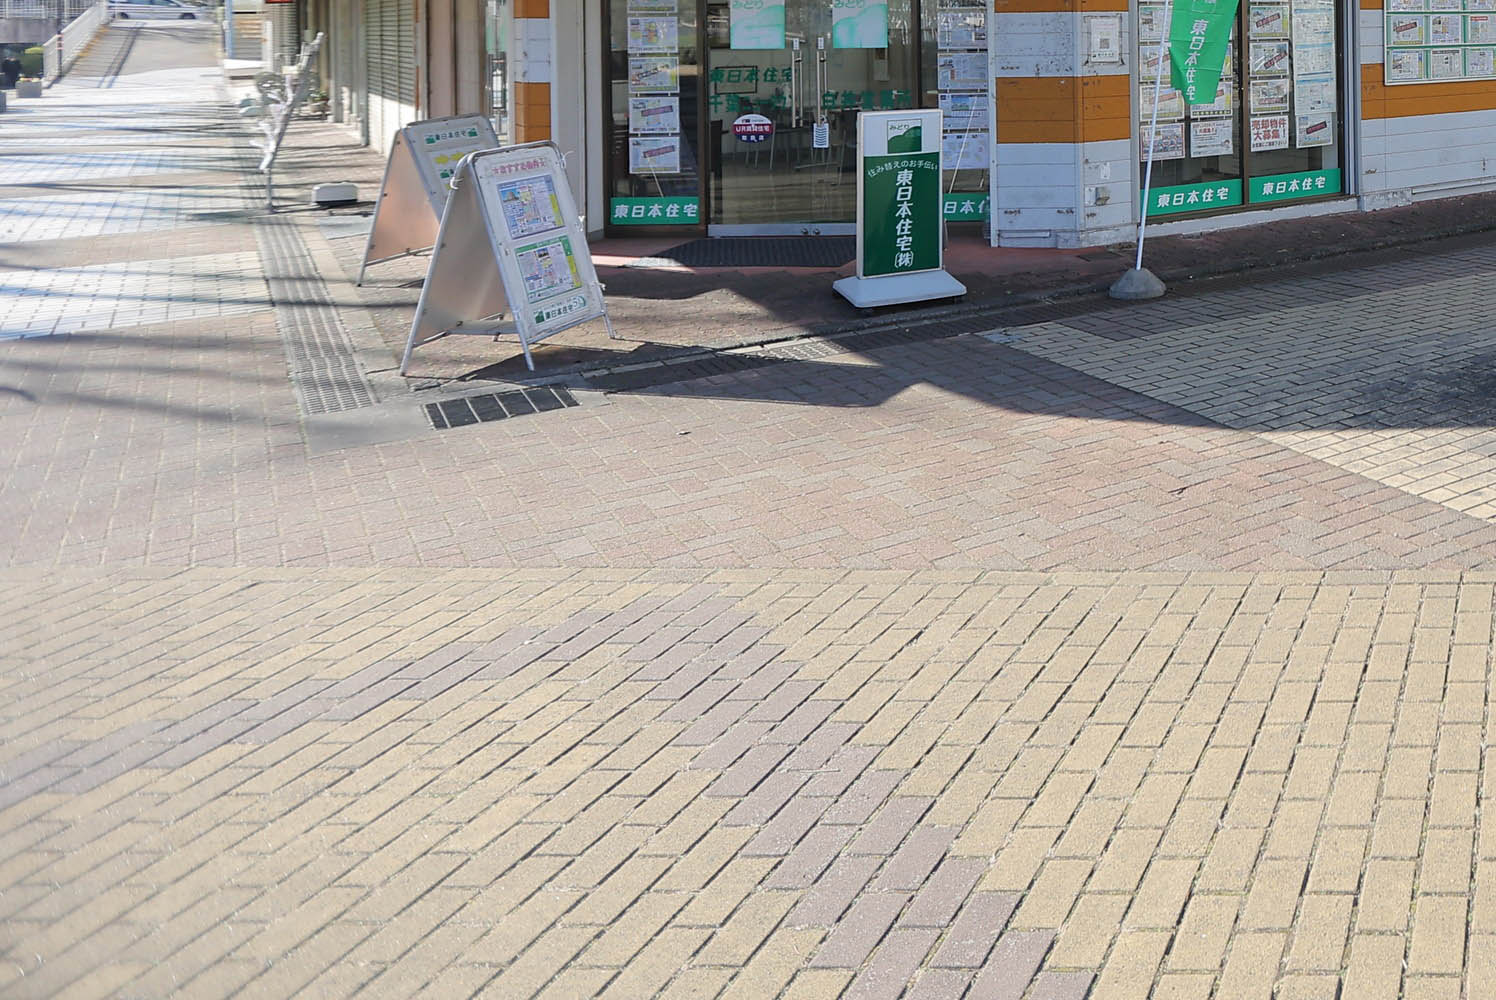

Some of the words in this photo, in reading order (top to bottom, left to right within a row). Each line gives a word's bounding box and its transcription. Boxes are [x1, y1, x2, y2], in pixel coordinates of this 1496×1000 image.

[834, 0, 865, 9] みどり
[1185, 19, 1208, 101] 東日本住宅
[1251, 117, 1287, 131] 売却物件
[867, 159, 938, 178] 住み替えのお手伝い
[1262, 176, 1326, 196] 東日本住宅
[1157, 187, 1229, 208] 東日本住宅
[614, 203, 698, 218] 東日本住宅
